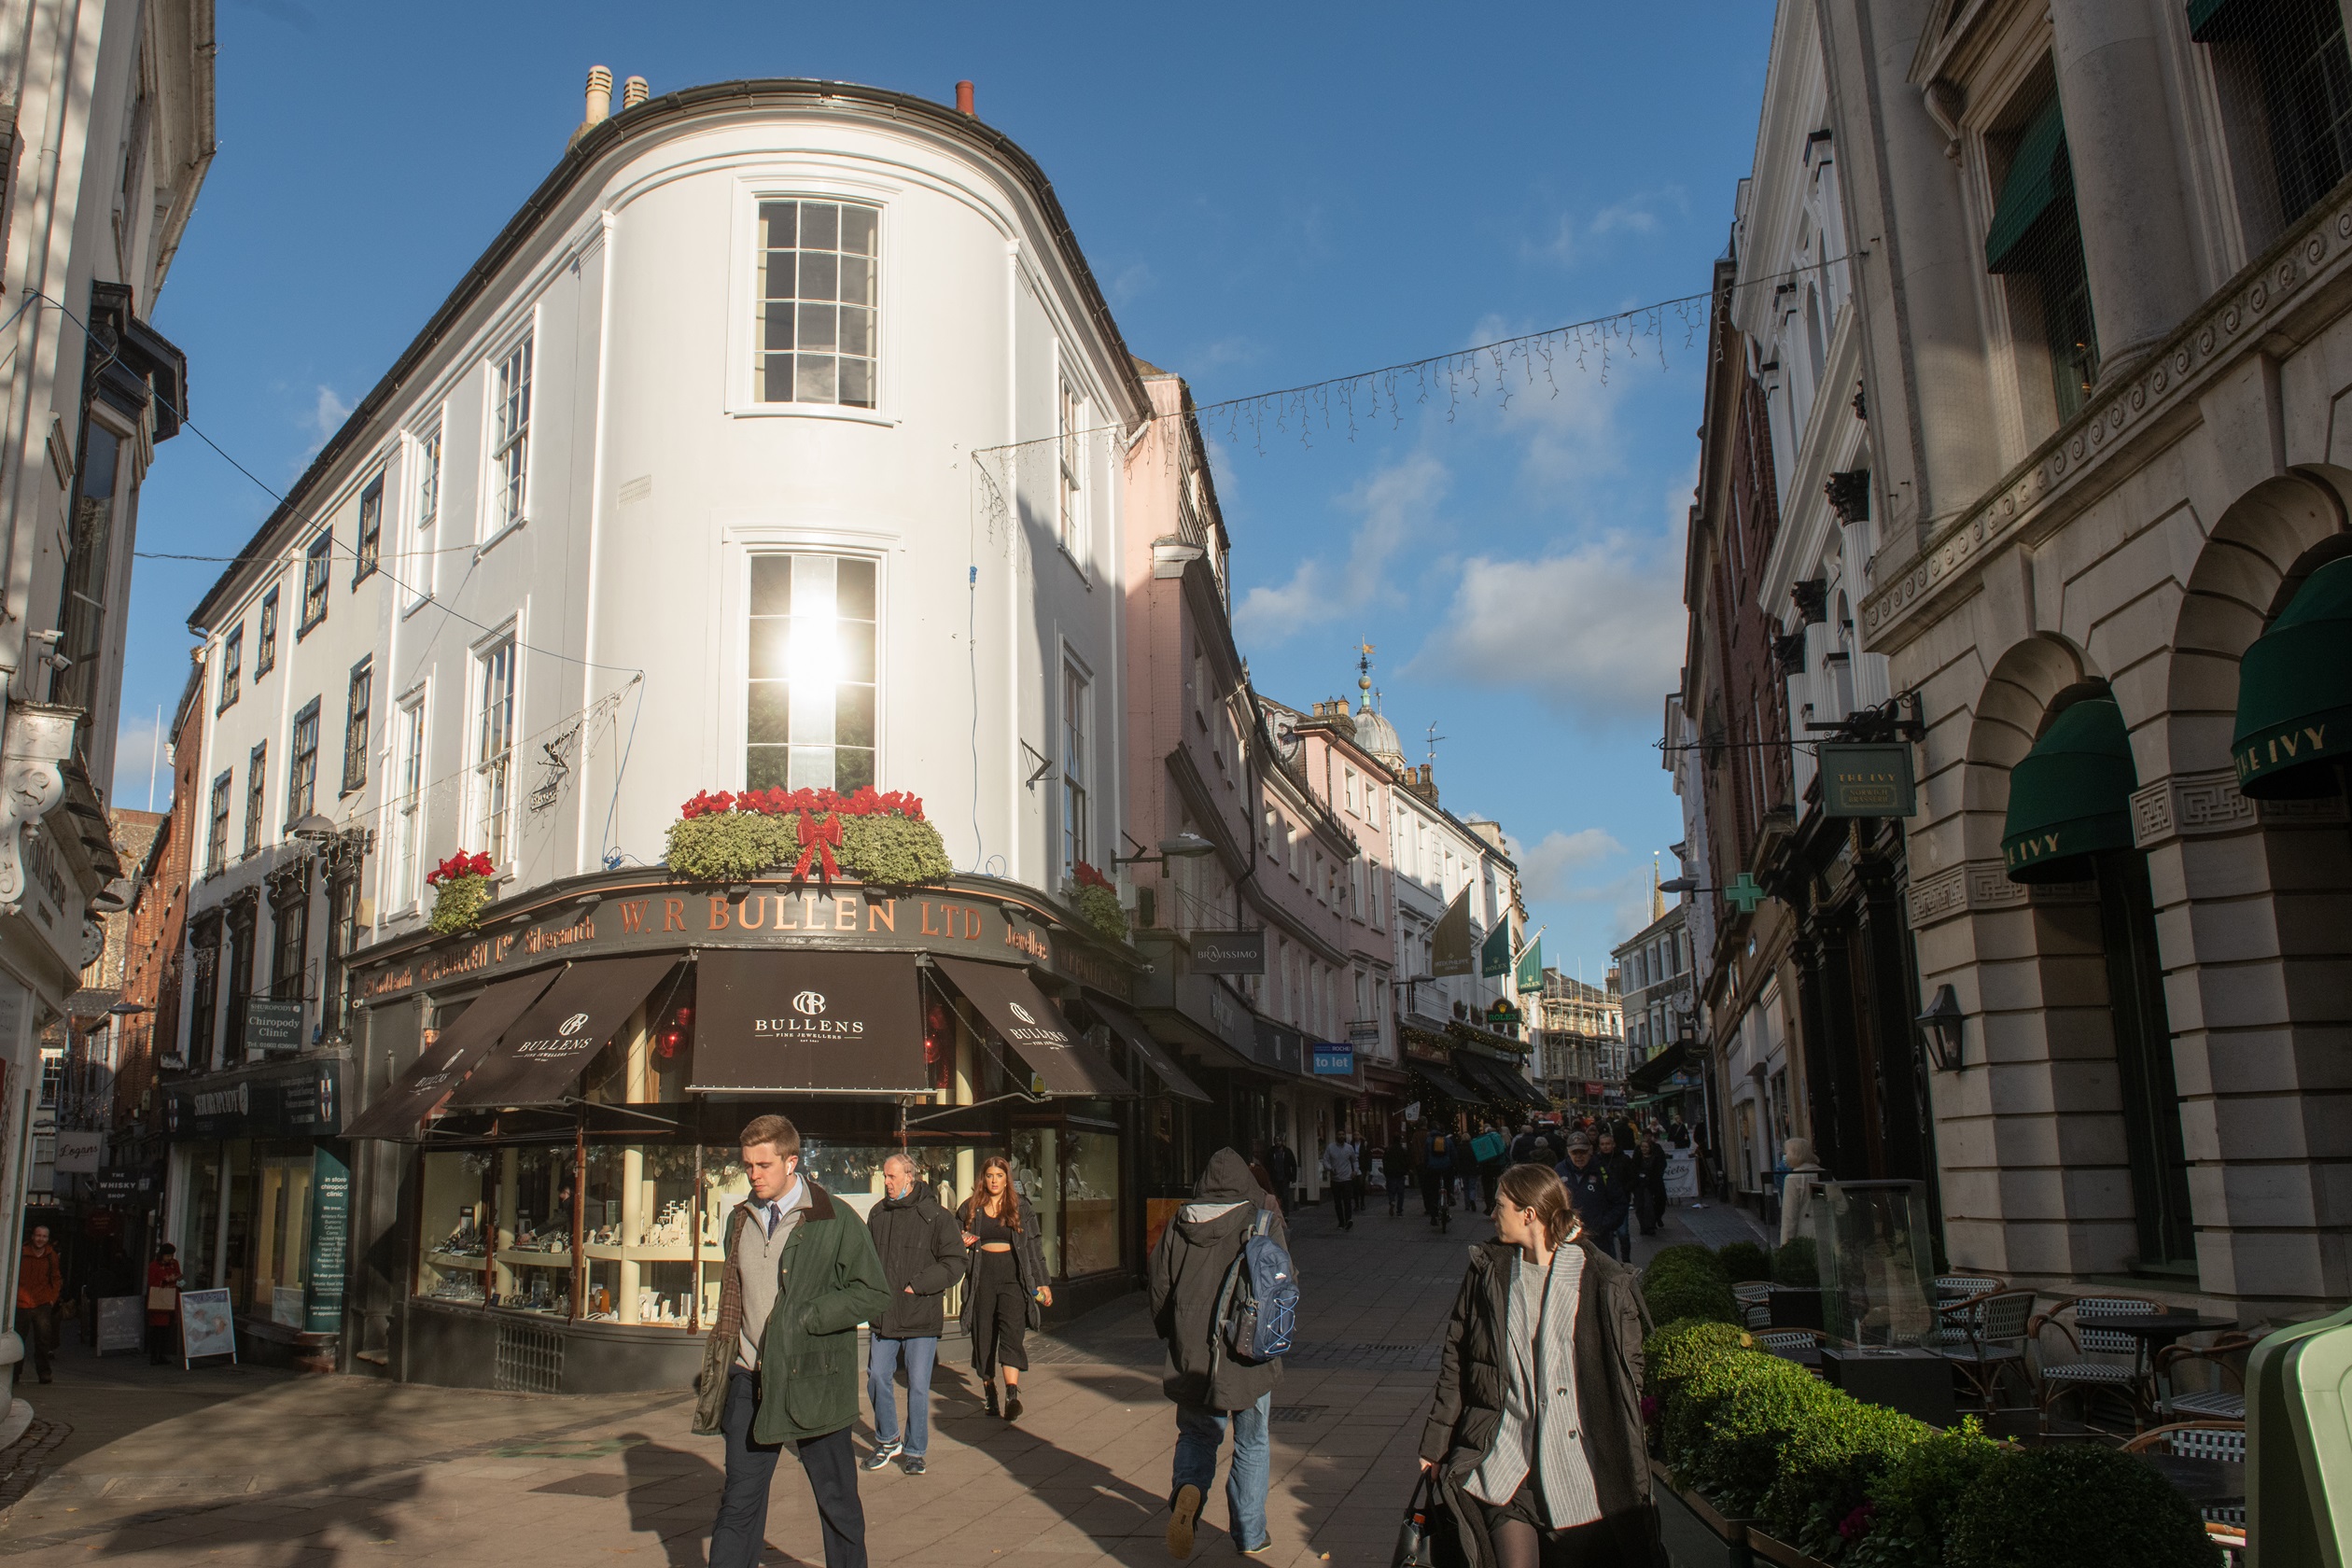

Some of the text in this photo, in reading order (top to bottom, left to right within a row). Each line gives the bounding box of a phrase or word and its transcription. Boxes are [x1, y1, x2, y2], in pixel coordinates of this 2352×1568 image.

[2234, 723, 2325, 779] THE IVY
[1838, 773, 1896, 782] THE IVY
[2020, 832, 2060, 861] IVY
[707, 895, 897, 933] BULLEN
[919, 901, 983, 941] LTD
[375, 966, 413, 996] Goldsmith
[442, 941, 489, 978] BULLEN
[525, 915, 595, 956] Silversmith
[1197, 945, 1257, 962] BRAVISSIMO
[1449, 958, 1469, 967] PHILIPPE
[1485, 962, 1508, 972] ROLEX
[1519, 980, 1541, 989] ROLEX
[250, 1003, 291, 1012] SHUROPODY
[249, 1015, 300, 1029] Chiropody
[755, 1018, 864, 1033] BULLENS
[259, 1028, 288, 1037] Clinic
[1009, 1028, 1069, 1042] BULLENS
[517, 1038, 593, 1053] BULLENS
[1315, 1056, 1348, 1067] to let
[414, 1072, 451, 1087] BULLENS
[194, 1090, 240, 1116] SHUROPODY
[60, 1144, 98, 1158] Logans
